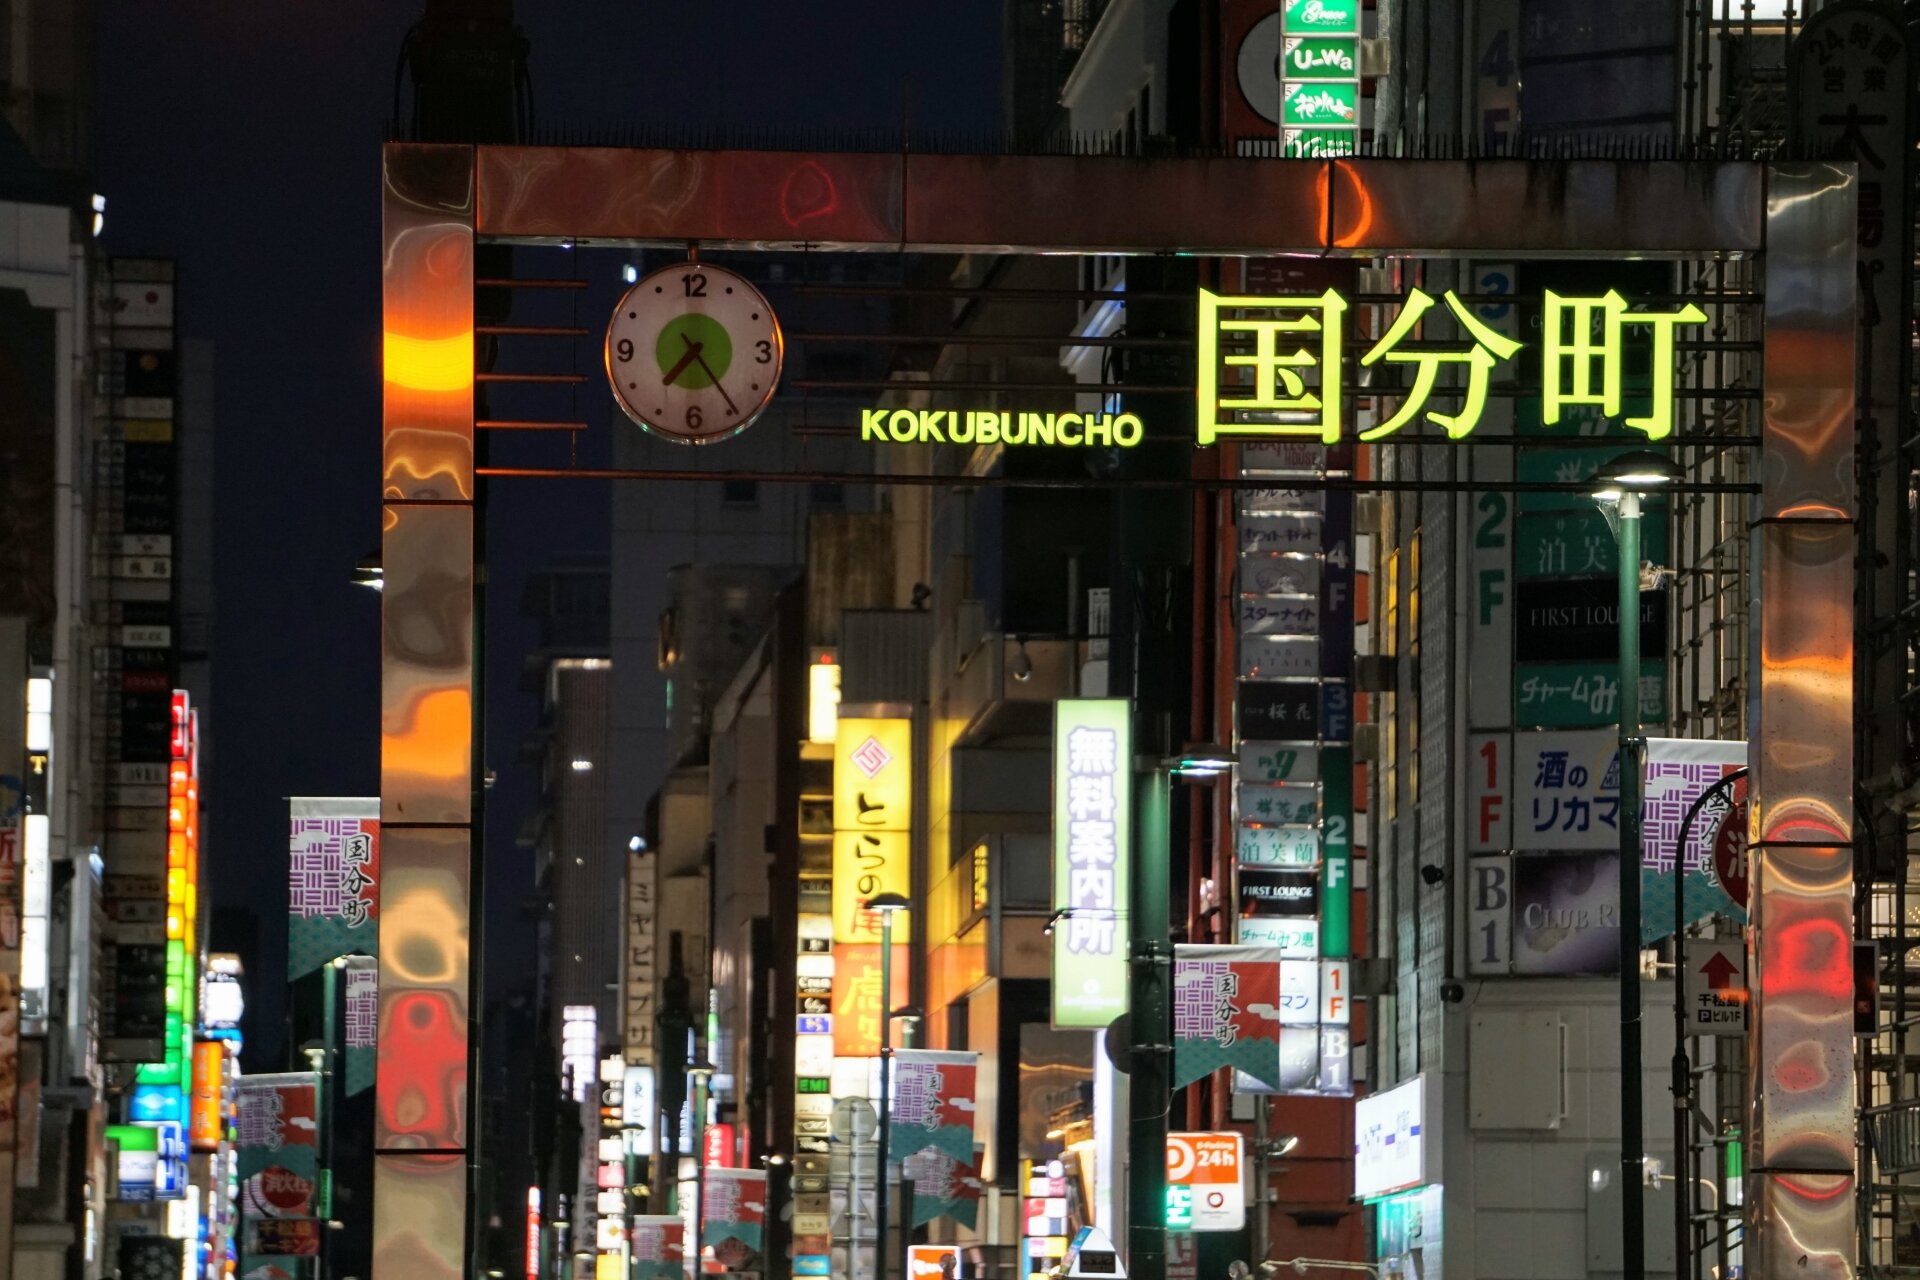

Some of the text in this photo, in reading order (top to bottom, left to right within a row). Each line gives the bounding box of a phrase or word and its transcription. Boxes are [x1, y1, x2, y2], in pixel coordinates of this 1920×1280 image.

[682, 273, 707, 297] 12
[617, 339, 634, 362] 9
[755, 340, 772, 364] 3
[1197, 286, 1708, 445] 国分町
[686, 406, 702, 429] 6
[861, 409, 1144, 449] KOKUBUNCHO
[1531, 603, 1656, 627] FIRST LOUGE
[1519, 675, 1663, 716] チャームみ恵
[1534, 751, 1589, 789] 酒の
[1533, 796, 1643, 832] リカマ
[1068, 726, 1117, 954] 無料案内所
[342, 833, 373, 927] 国分町
[1243, 885, 1313, 898] FIRST LOUNGE
[1214, 973, 1240, 1047] 国分町
[1197, 1150, 1235, 1167] 24h
